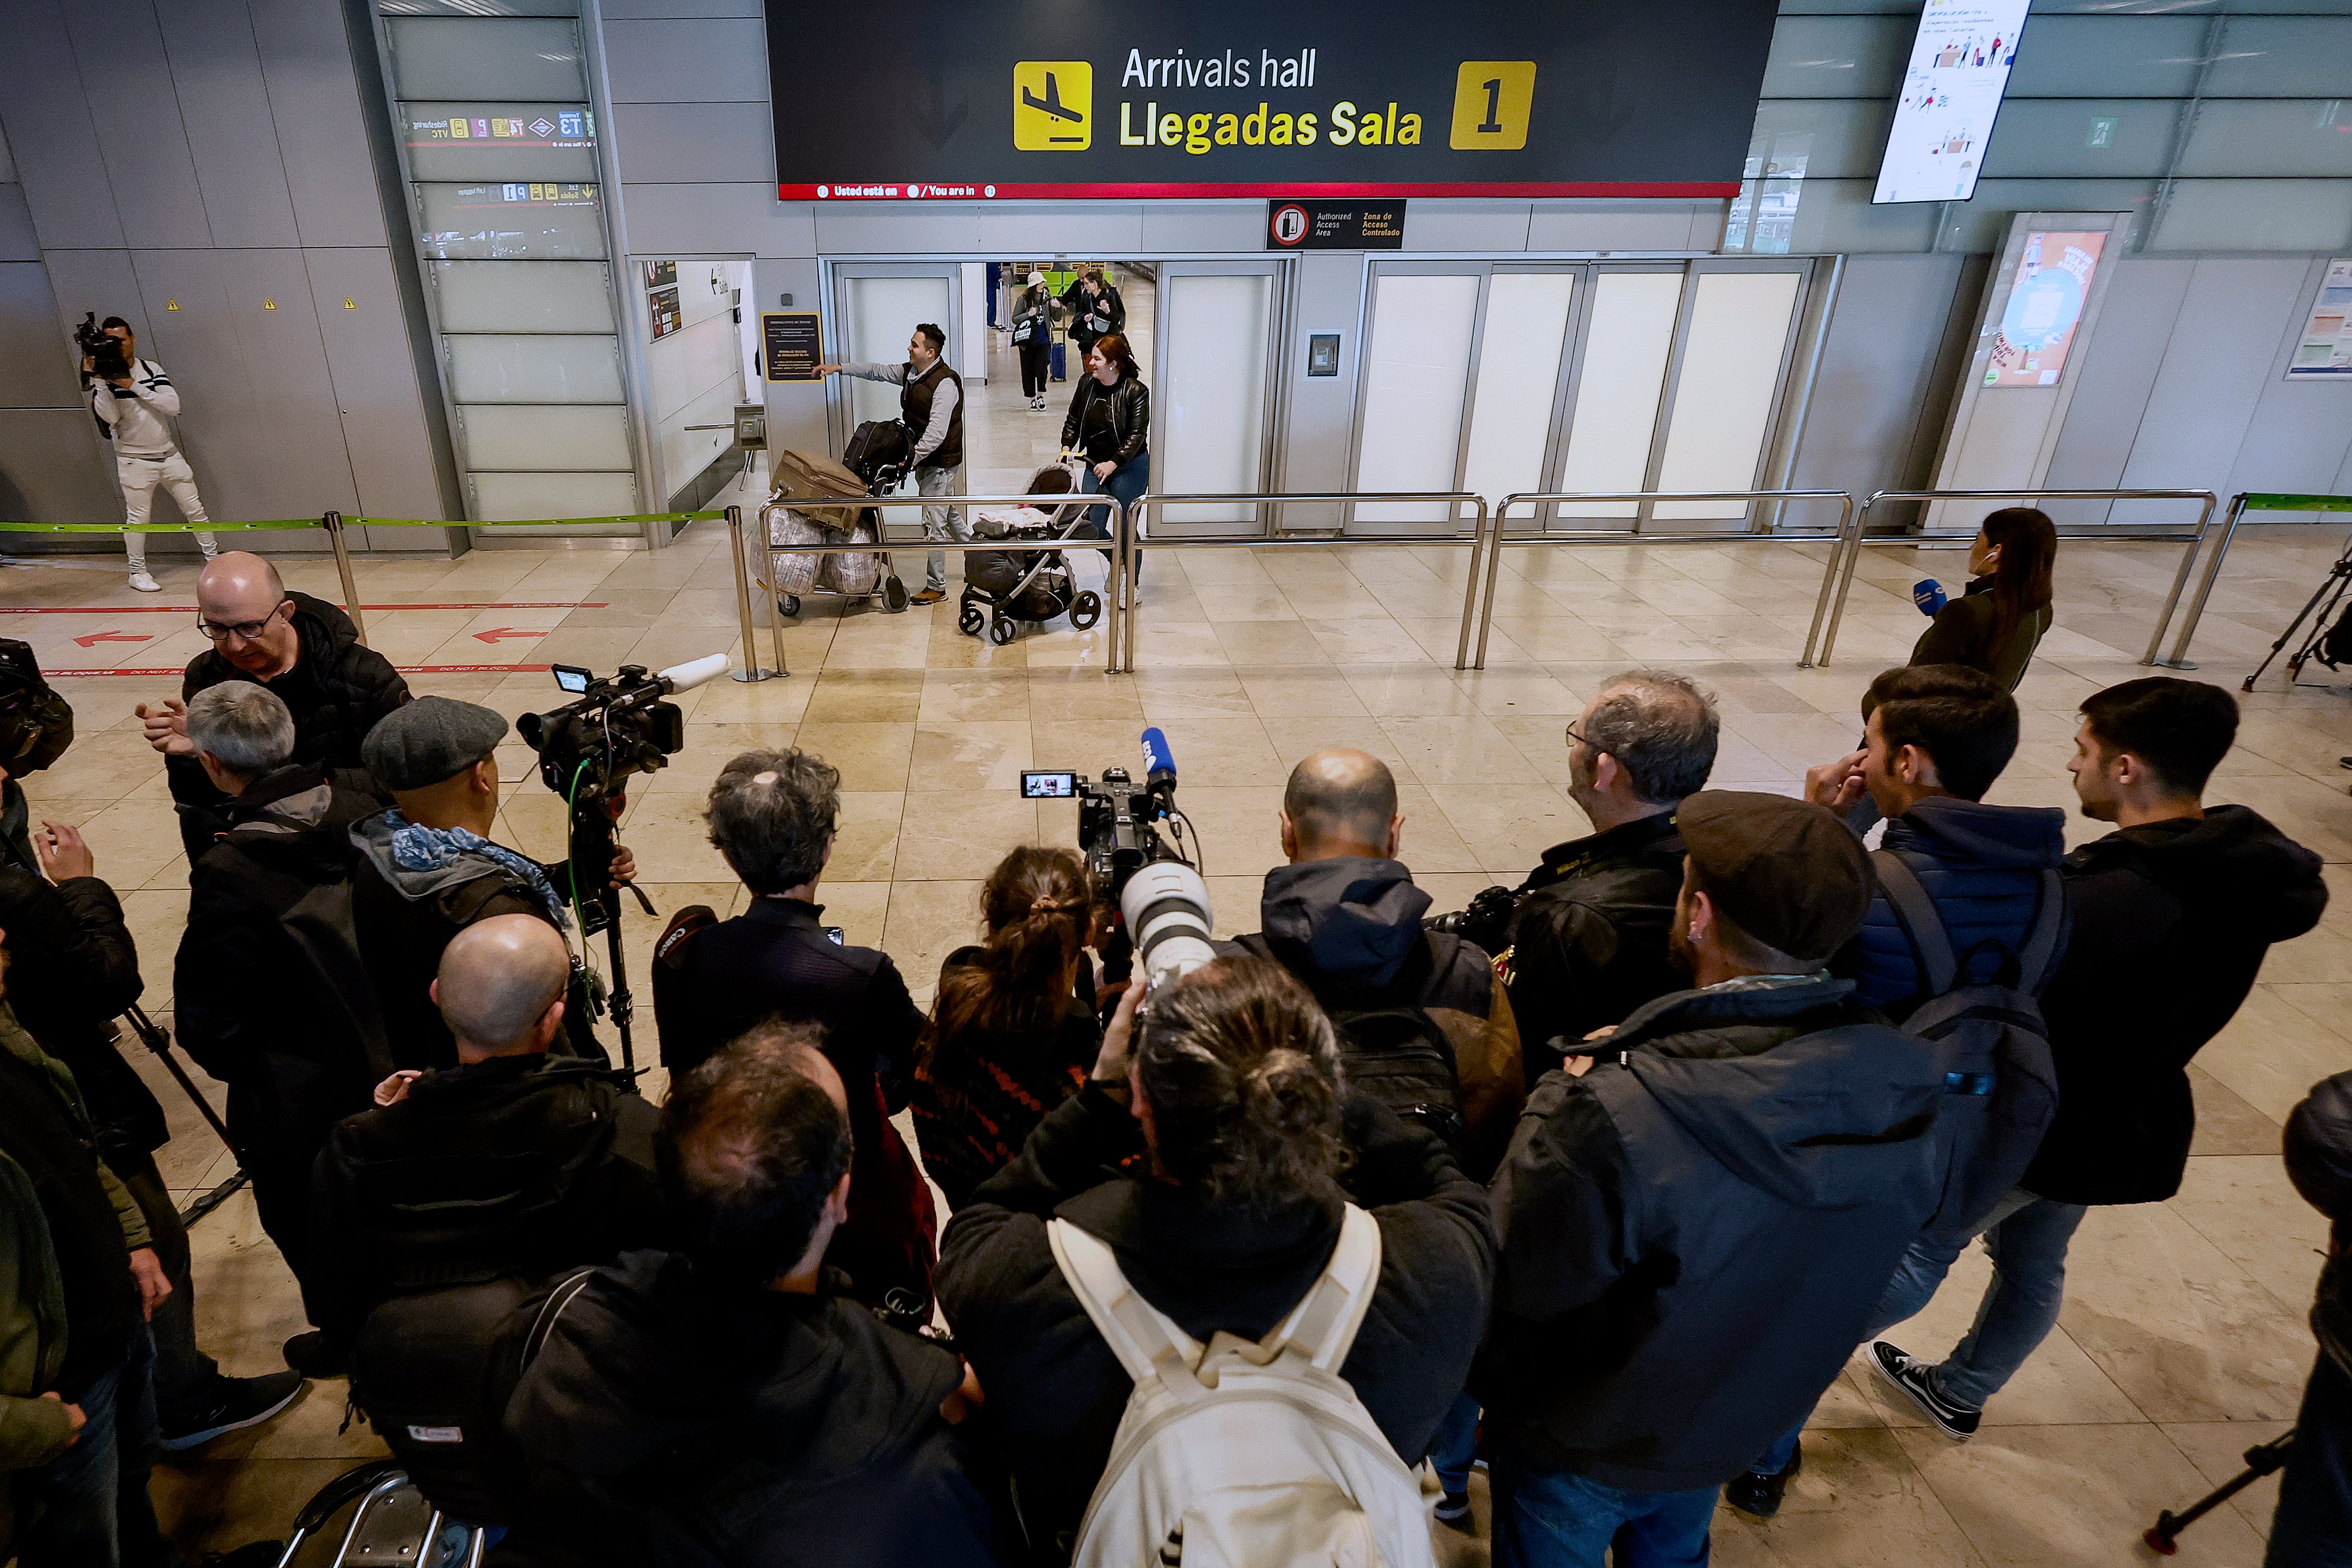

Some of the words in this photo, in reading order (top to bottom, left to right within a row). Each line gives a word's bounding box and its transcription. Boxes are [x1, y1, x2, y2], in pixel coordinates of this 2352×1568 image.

[1122, 49, 1250, 88] Arrivals
[1261, 49, 1316, 87] hall
[1477, 78, 1503, 134] 1
[1120, 102, 1318, 155] Llegadas
[1329, 101, 1422, 146] Sala
[834, 185, 862, 196] Usted
[863, 185, 884, 196] está
[885, 187, 898, 196] en
[929, 185, 947, 196] You
[948, 187, 965, 196] are
[966, 185, 975, 196] in
[1317, 212, 1352, 220] Authorized
[1361, 228, 1401, 236] Controlado
[657, 927, 686, 958] Canon
